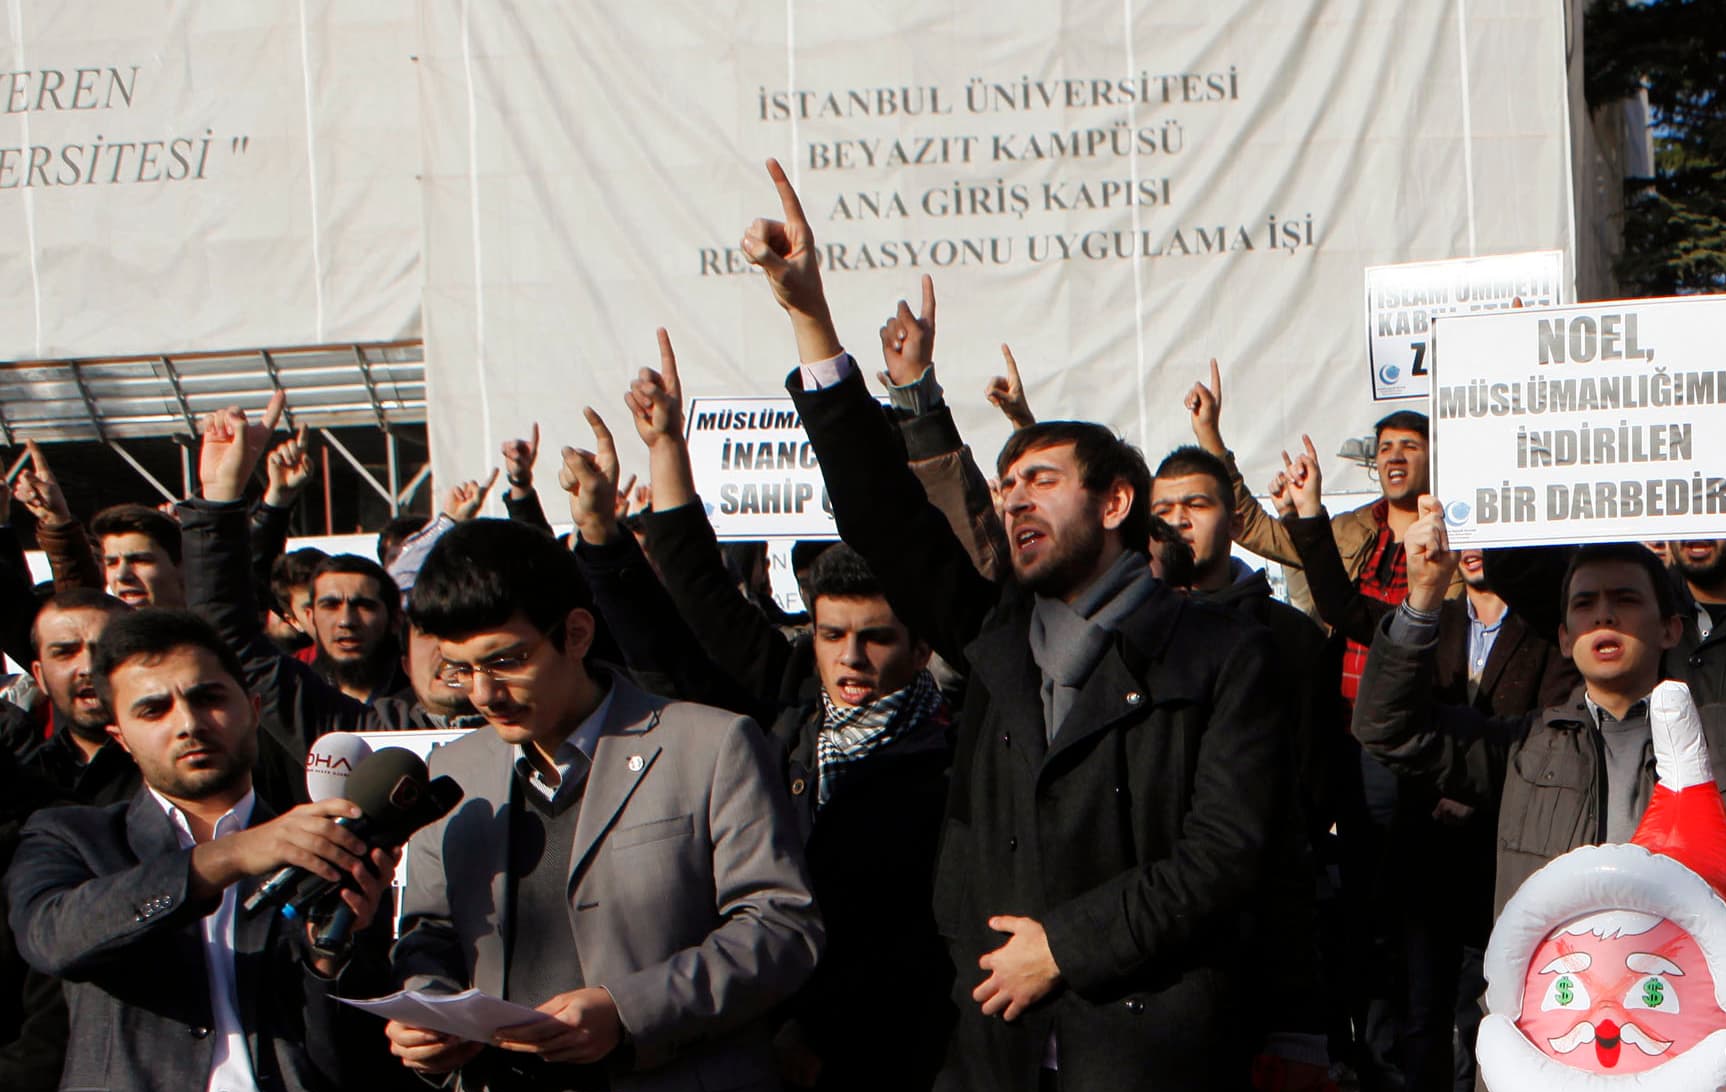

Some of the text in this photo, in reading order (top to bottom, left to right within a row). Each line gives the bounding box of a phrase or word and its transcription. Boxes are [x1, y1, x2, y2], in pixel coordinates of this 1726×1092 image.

[0, 66, 142, 113] EREN
[758, 65, 1240, 121] İSTANBUL ÜNİVERSİTESİ
[808, 120, 1185, 170] BEYAZIT KAMPÜSÜ
[829, 178, 1171, 221] ANA GİRİŞ KAPISI
[699, 213, 1314, 276] RERASYONU UYGULAMA İŞİ
[1538, 313, 1655, 365] NOEL,
[1516, 420, 1693, 469] İNDİRİLEN
[720, 478, 813, 515] SAHİP
[1476, 480, 1537, 525] BİR
